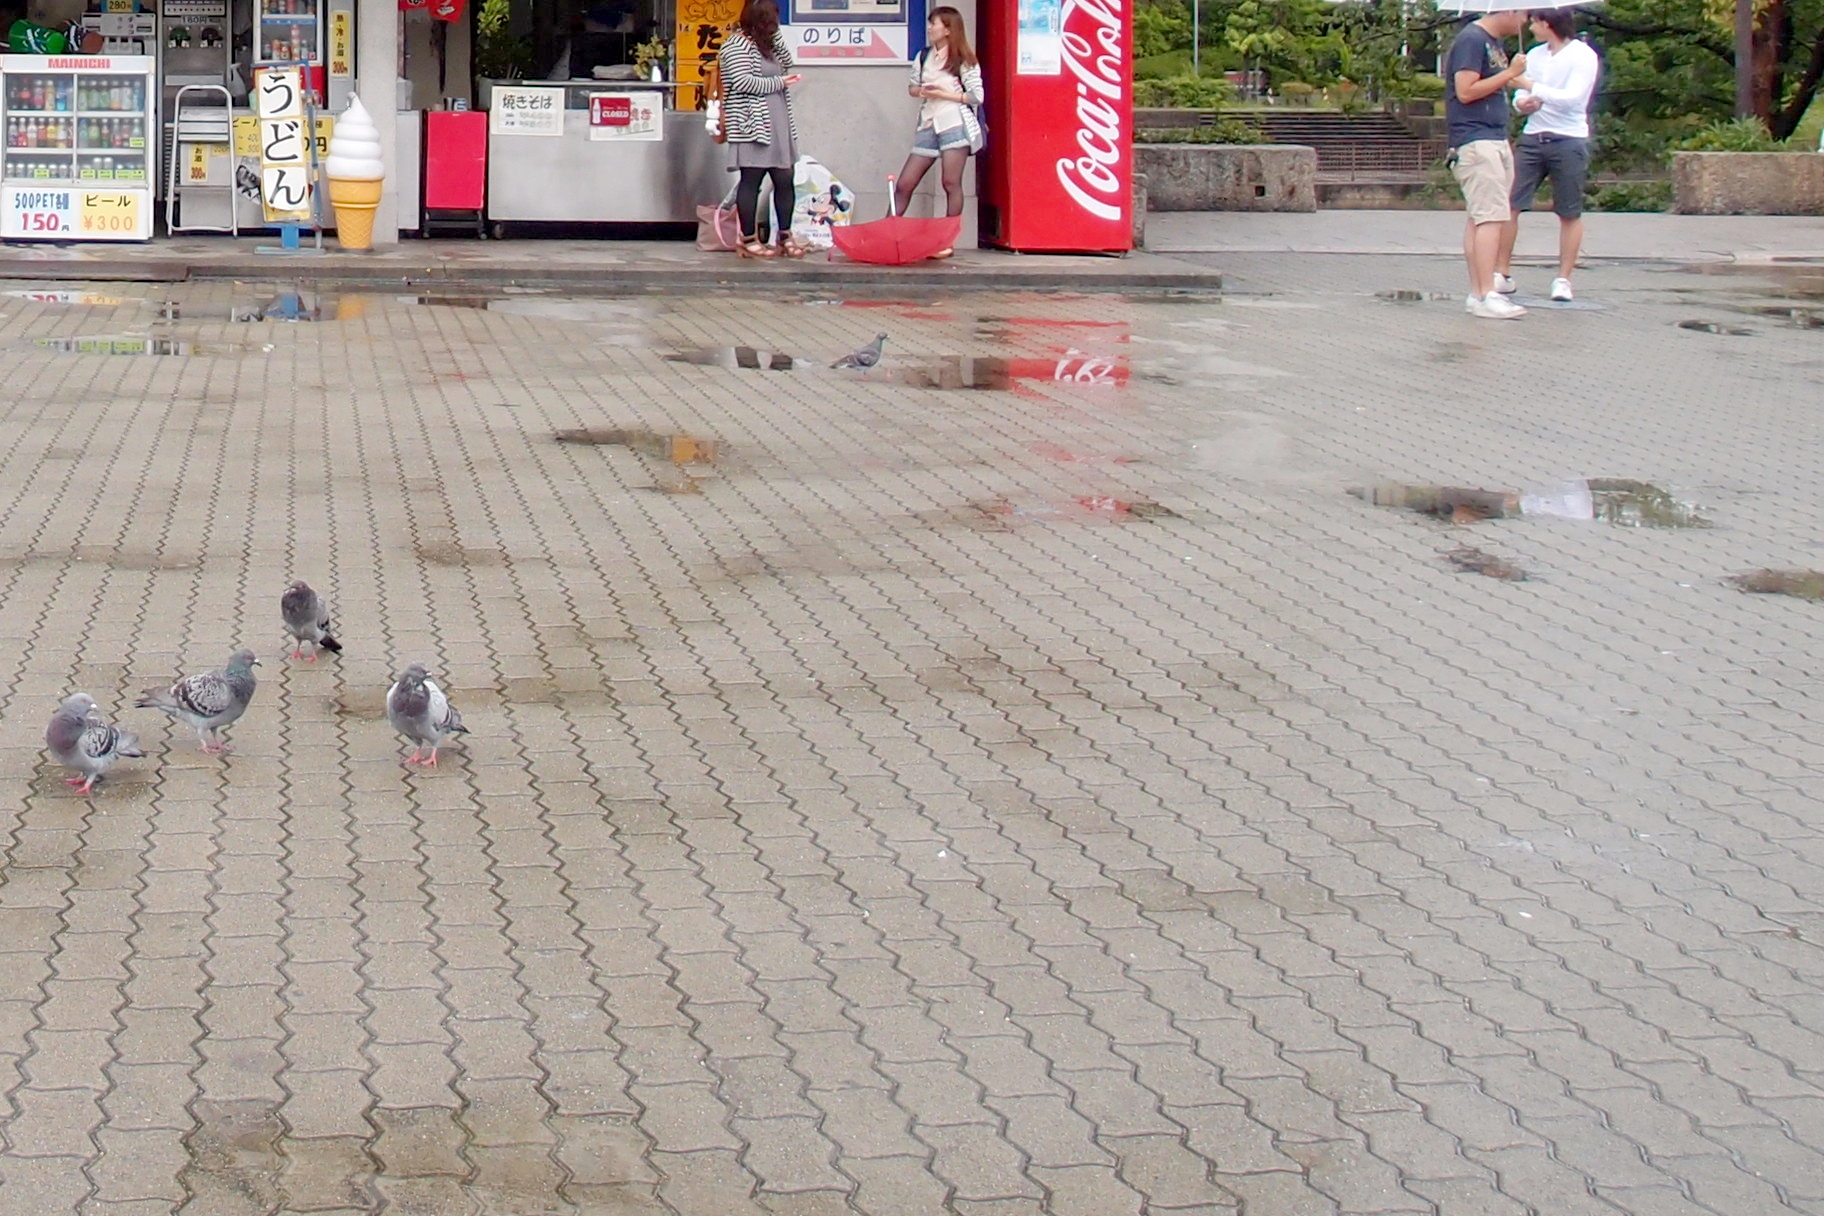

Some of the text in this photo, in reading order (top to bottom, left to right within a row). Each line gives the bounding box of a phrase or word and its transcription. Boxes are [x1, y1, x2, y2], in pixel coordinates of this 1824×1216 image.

[803, 27, 865, 44] のりば
[47, 58, 111, 69] MAINICHI
[502, 94, 553, 110] 焼きそば
[263, 73, 306, 206] うどん
[86, 194, 131, 208] ビール
[83, 215, 133, 232] ¥300
